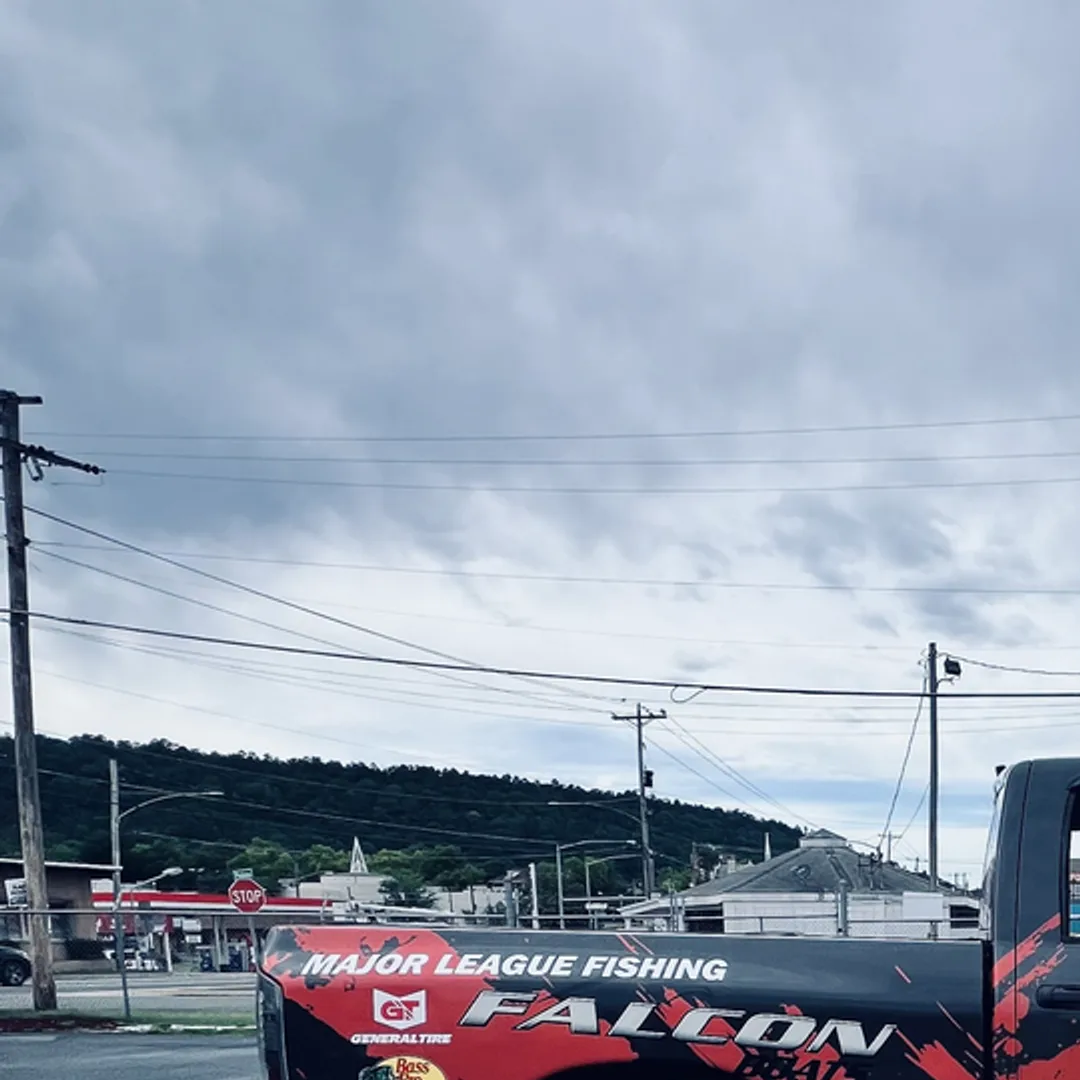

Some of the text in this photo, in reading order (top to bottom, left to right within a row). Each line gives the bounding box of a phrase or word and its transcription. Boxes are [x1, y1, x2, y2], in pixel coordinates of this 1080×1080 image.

[232, 890, 261, 903] STOP
[301, 954, 729, 981] MAJOR LEAGUE FISHING
[459, 990, 898, 1056] FALCON
[396, 1058, 430, 1074] Bass
